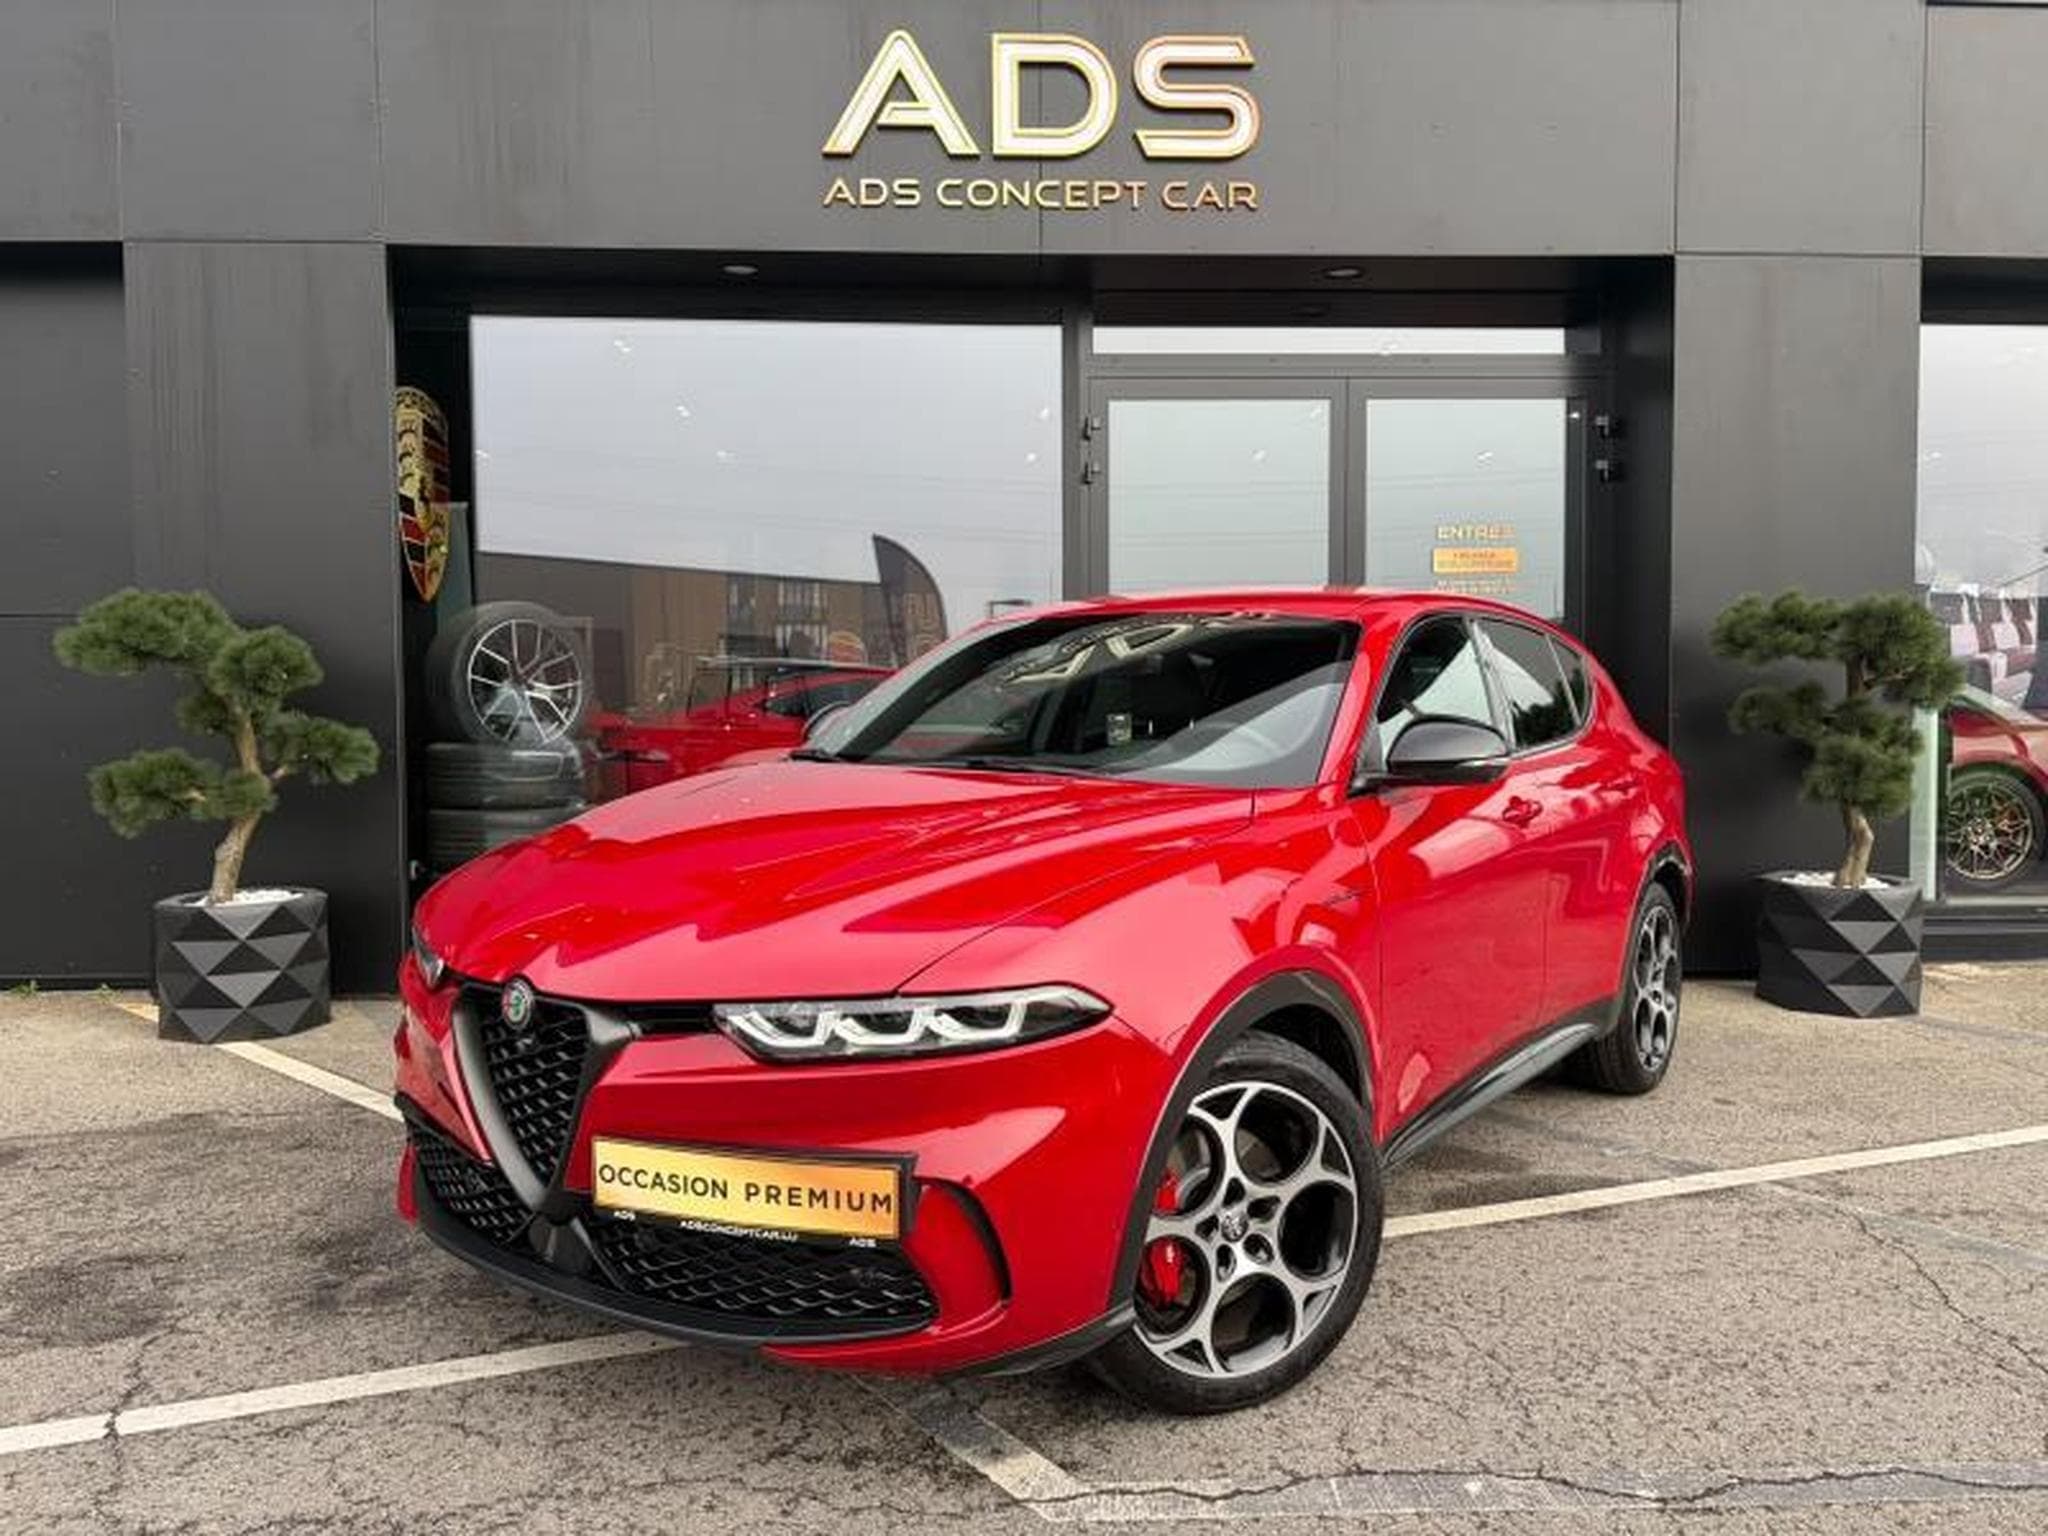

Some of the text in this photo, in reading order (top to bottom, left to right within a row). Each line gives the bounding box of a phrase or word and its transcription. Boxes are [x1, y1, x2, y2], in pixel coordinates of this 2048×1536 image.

[822, 30, 1262, 160] ADS
[823, 178, 1259, 211] ADS CONCEPT CAR
[598, 1163, 893, 1214] OCCASION PREMIUM
